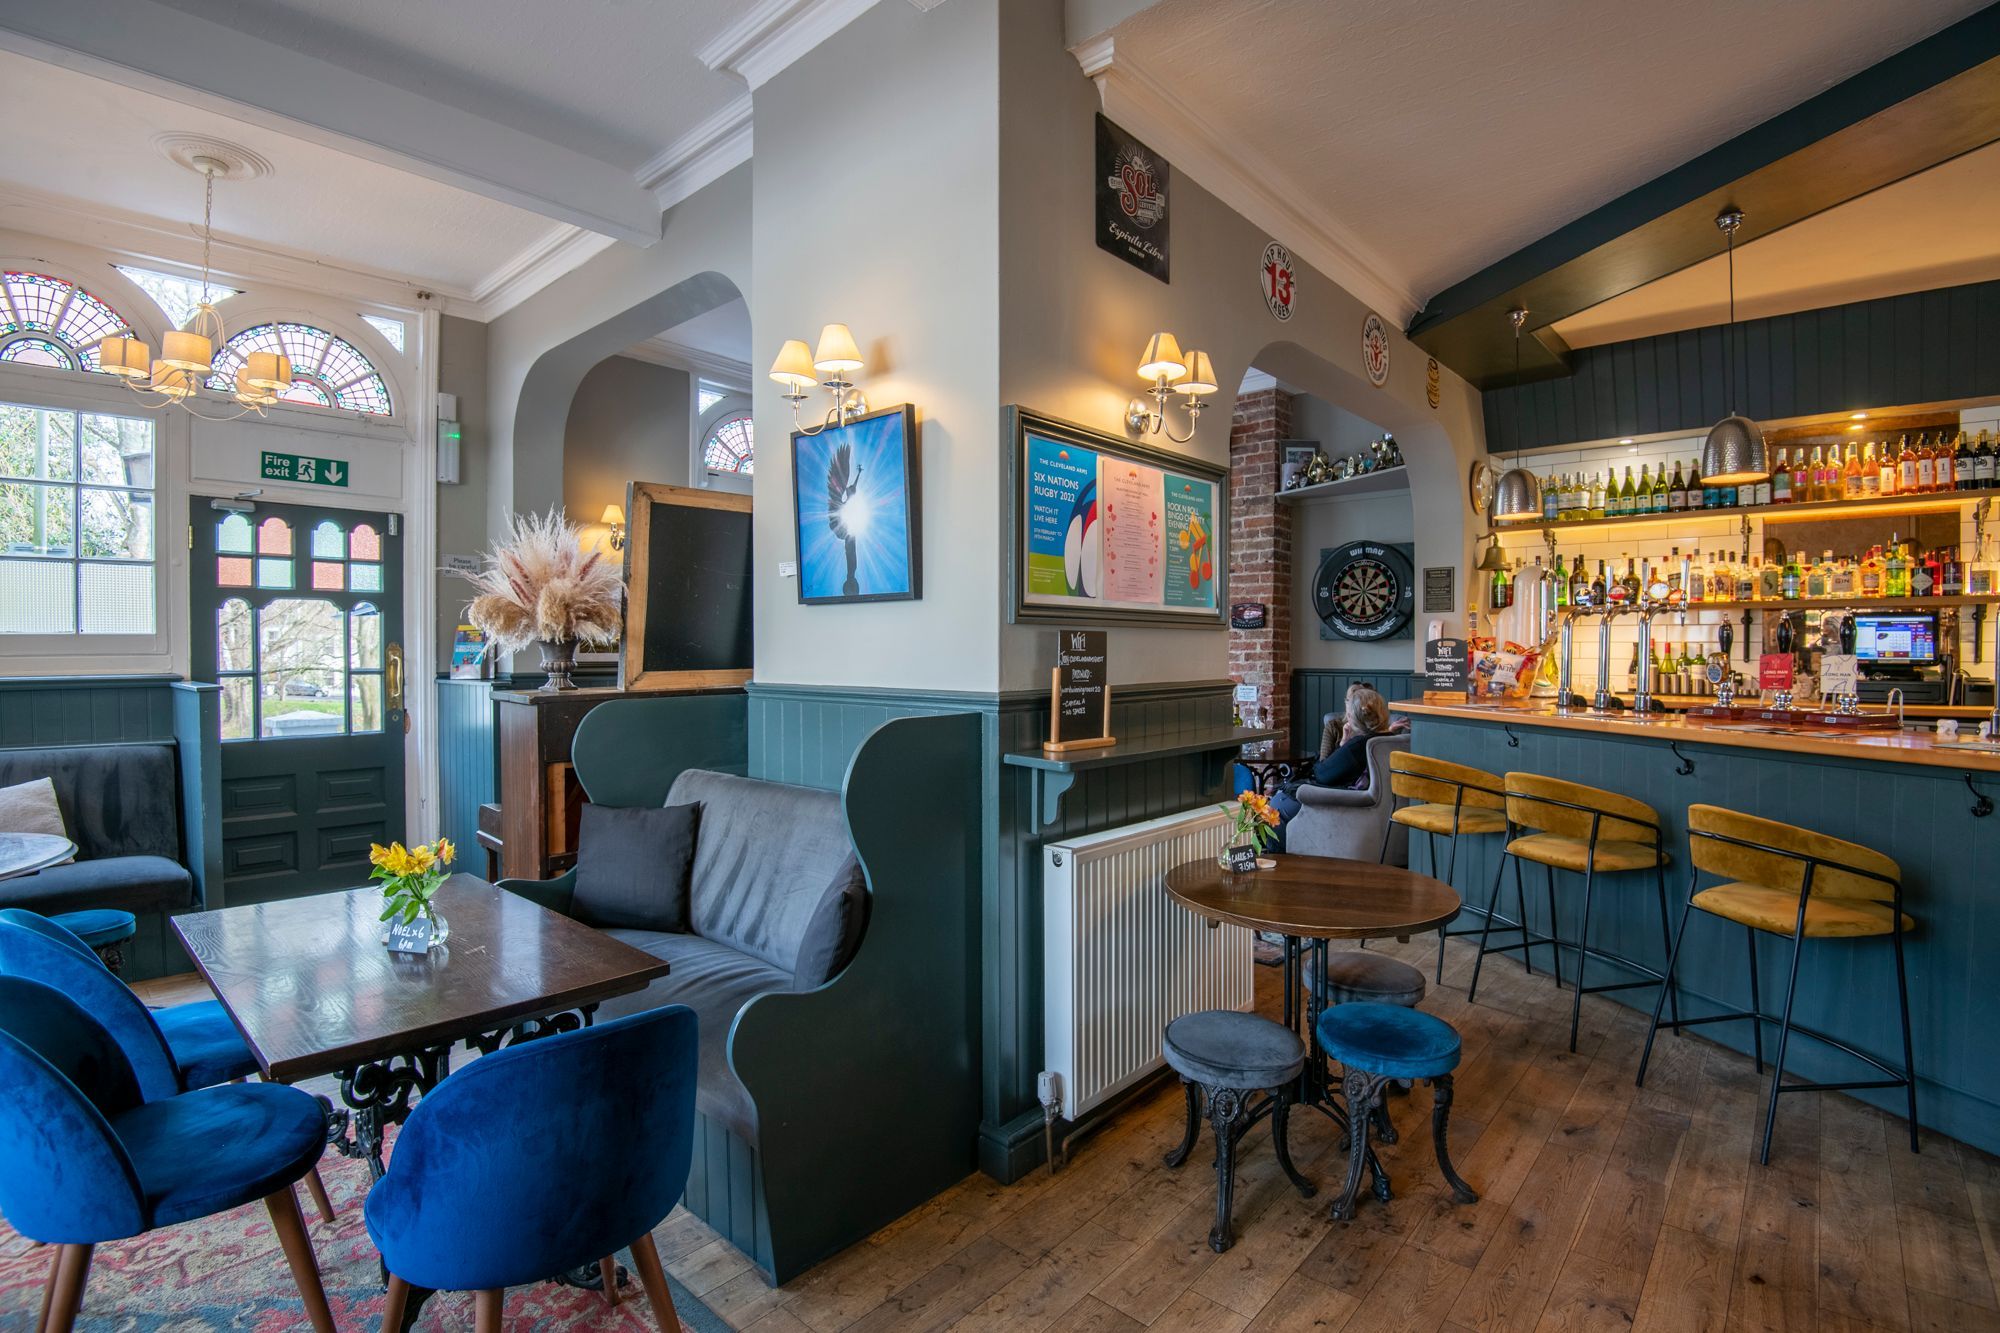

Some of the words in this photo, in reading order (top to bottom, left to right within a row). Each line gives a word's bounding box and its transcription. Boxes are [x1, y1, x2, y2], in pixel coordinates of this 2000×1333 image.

[1121, 165, 1156, 216] SOL
[1143, 241, 1164, 260] Libre
[1264, 249, 1275, 275] HOP
[1269, 261, 1291, 305] 13
[1269, 295, 1290, 317] LAGER
[265, 455, 290, 467] Fire
[1039, 458, 1049, 466] THE
[1050, 460, 1076, 472] CLEVELAND
[1076, 467, 1088, 475] ARMS
[265, 467, 290, 477] exit
[1034, 472, 1046, 482] SIX
[1047, 475, 1079, 490] NATIONS
[1034, 486, 1058, 499] RUGBY
[1060, 491, 1075, 503] 2022
[1034, 505, 1053, 514] WATCH
[1168, 502, 1182, 512] ROCK
[1182, 505, 1187, 513] N
[1188, 506, 1199, 515] ROLL
[1168, 511, 1184, 521] BINGO
[1045, 516, 1058, 525] HERE
[1168, 519, 1189, 530] EVENING
[391, 923, 411, 937] NOEL
